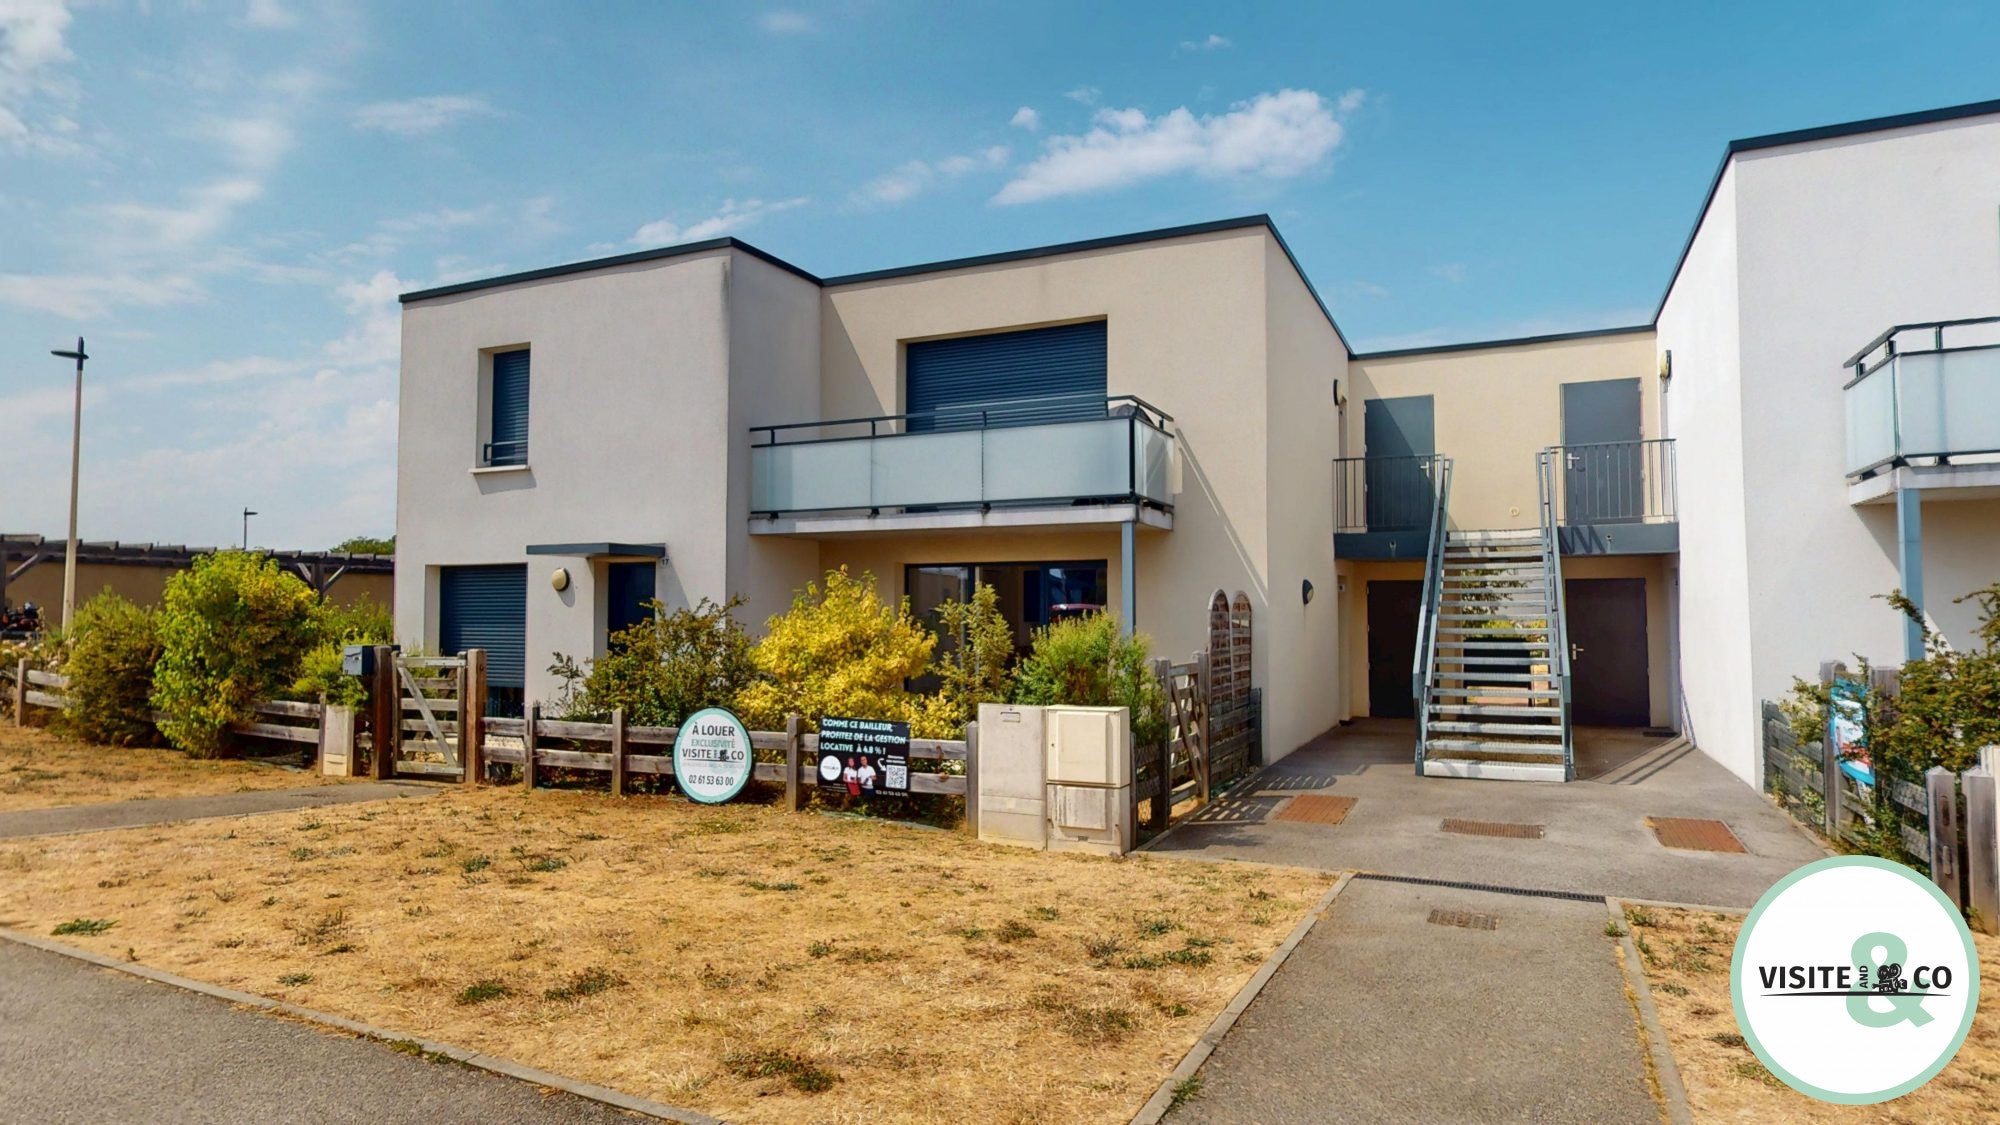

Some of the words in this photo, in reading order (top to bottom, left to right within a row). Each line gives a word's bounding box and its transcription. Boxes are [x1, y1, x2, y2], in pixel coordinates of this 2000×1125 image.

[692, 722, 699, 735] À
[701, 725, 735, 737] LOUER
[822, 719, 848, 728] COMME
[849, 721, 859, 729] CE
[821, 730, 853, 740] PROFITEZ
[854, 733, 863, 741] DE
[864, 734, 873, 742] LA
[875, 735, 906, 744] GESTION
[691, 739, 736, 749] EXCLUSIVITÉ
[820, 742, 853, 752] LOCATIVE
[856, 743, 862, 752] À
[682, 748, 712, 758] VISITE
[731, 750, 744, 760] CO
[689, 774, 697, 784] 02
[698, 775, 705, 784] 61
[706, 775, 715, 785] 53
[715, 776, 723, 786] 63
[725, 776, 734, 786] 00
